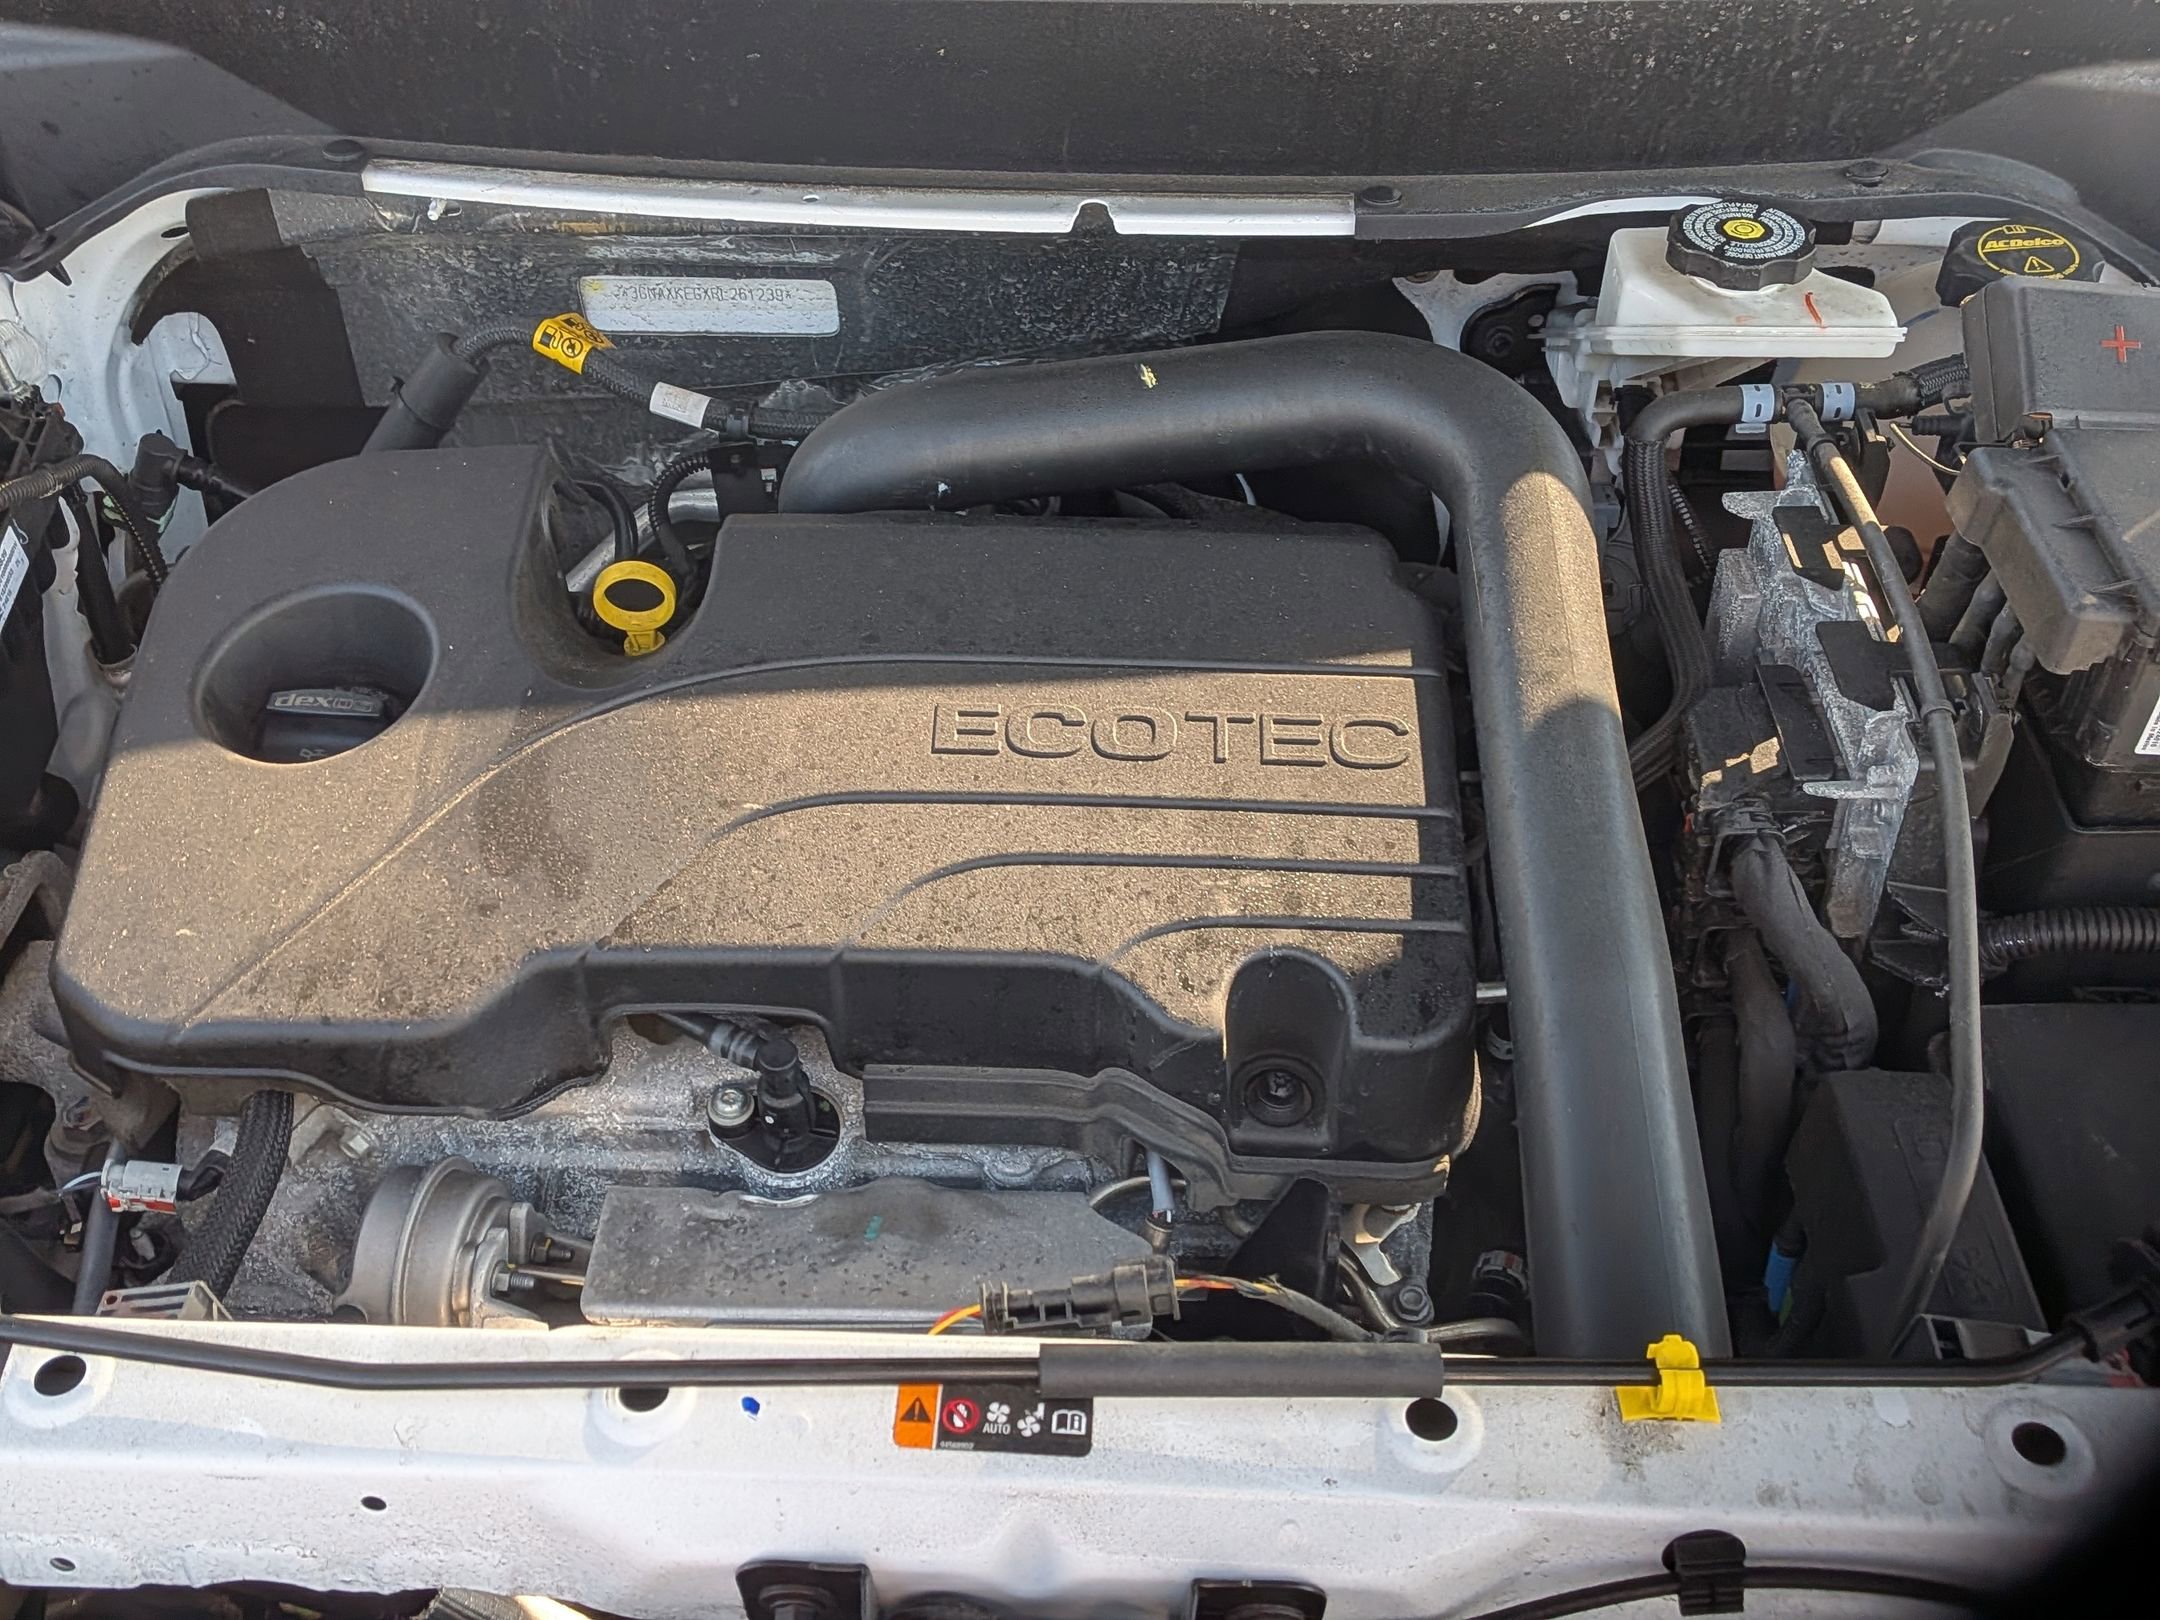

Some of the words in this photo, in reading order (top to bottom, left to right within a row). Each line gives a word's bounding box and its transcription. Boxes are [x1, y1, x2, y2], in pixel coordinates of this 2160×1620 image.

[1985, 237, 2065, 249] ACDelco
[274, 693, 373, 713] dexos
[930, 700, 1411, 770] ECOTEC
[982, 1423, 1011, 1435] AUTO
